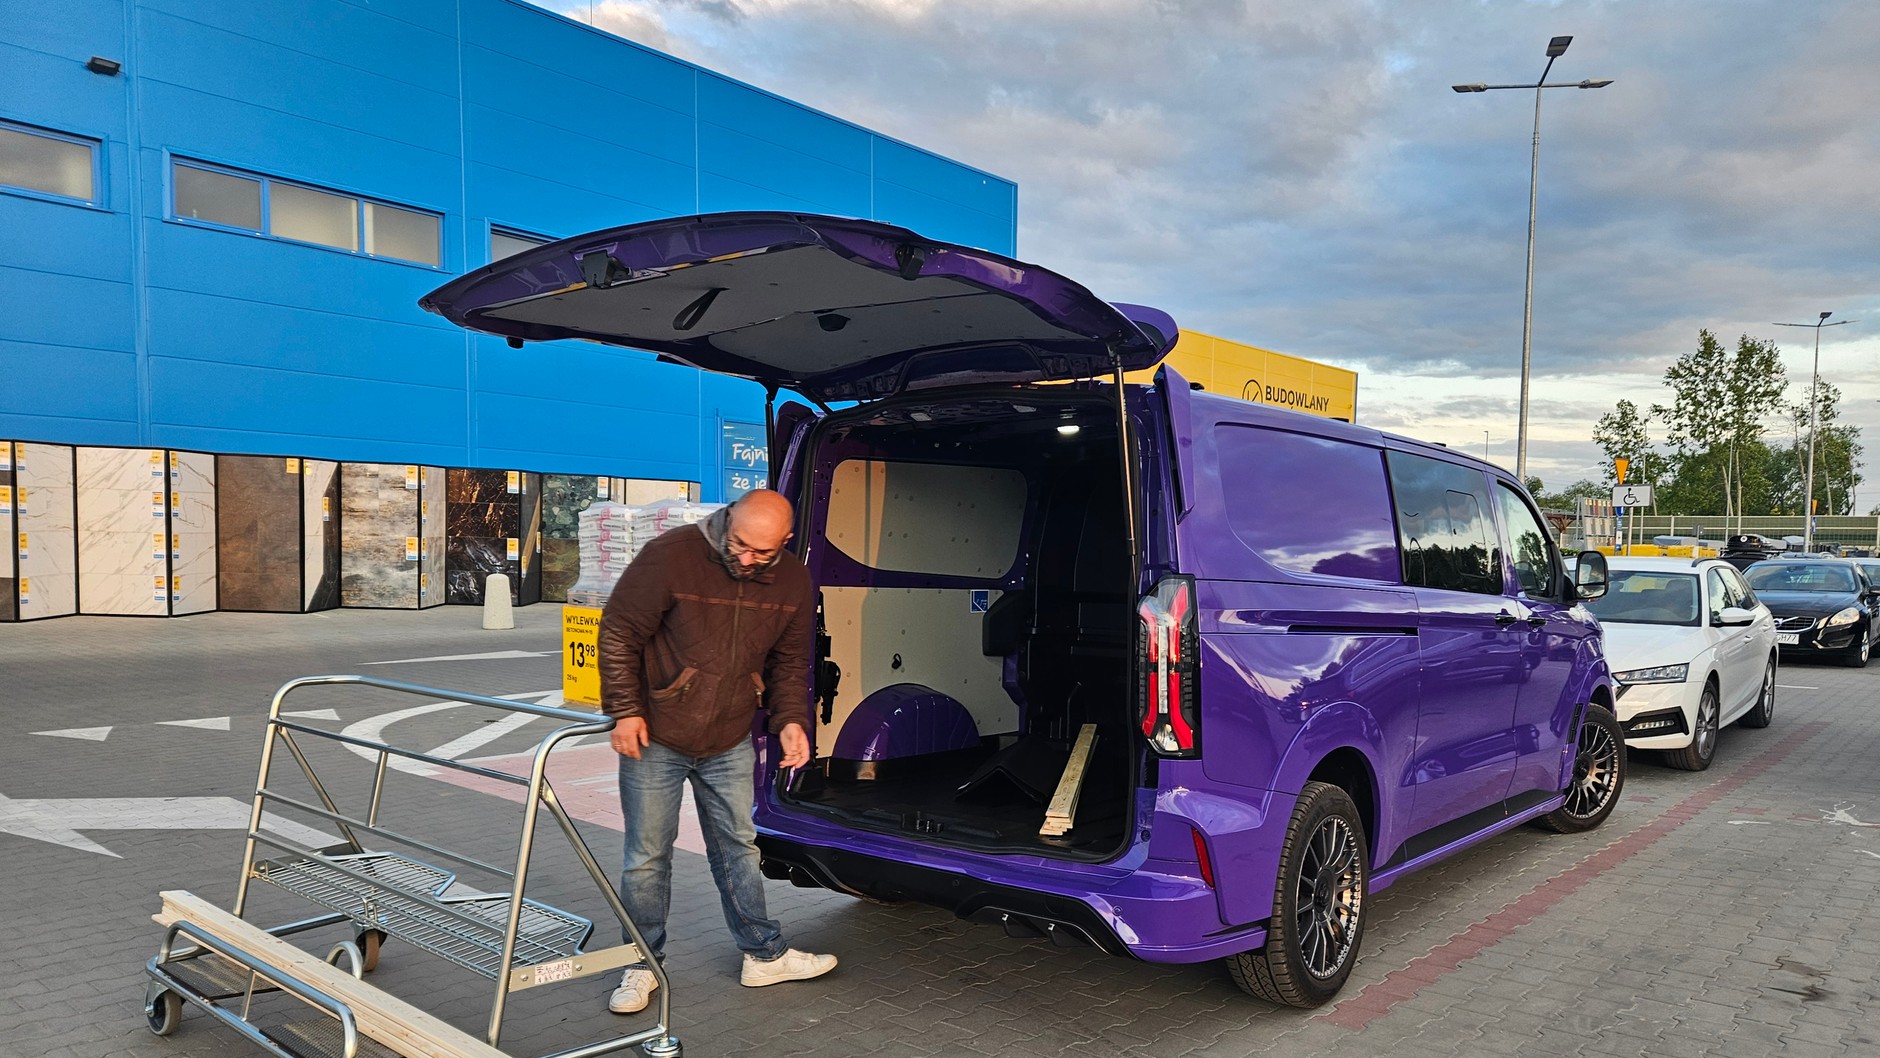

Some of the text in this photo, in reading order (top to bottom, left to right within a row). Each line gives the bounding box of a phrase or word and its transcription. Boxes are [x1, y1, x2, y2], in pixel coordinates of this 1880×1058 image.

[1265, 385, 1330, 412] BUDOWLANY
[731, 473, 751, 490] że
[566, 615, 600, 626] WYLEWKA
